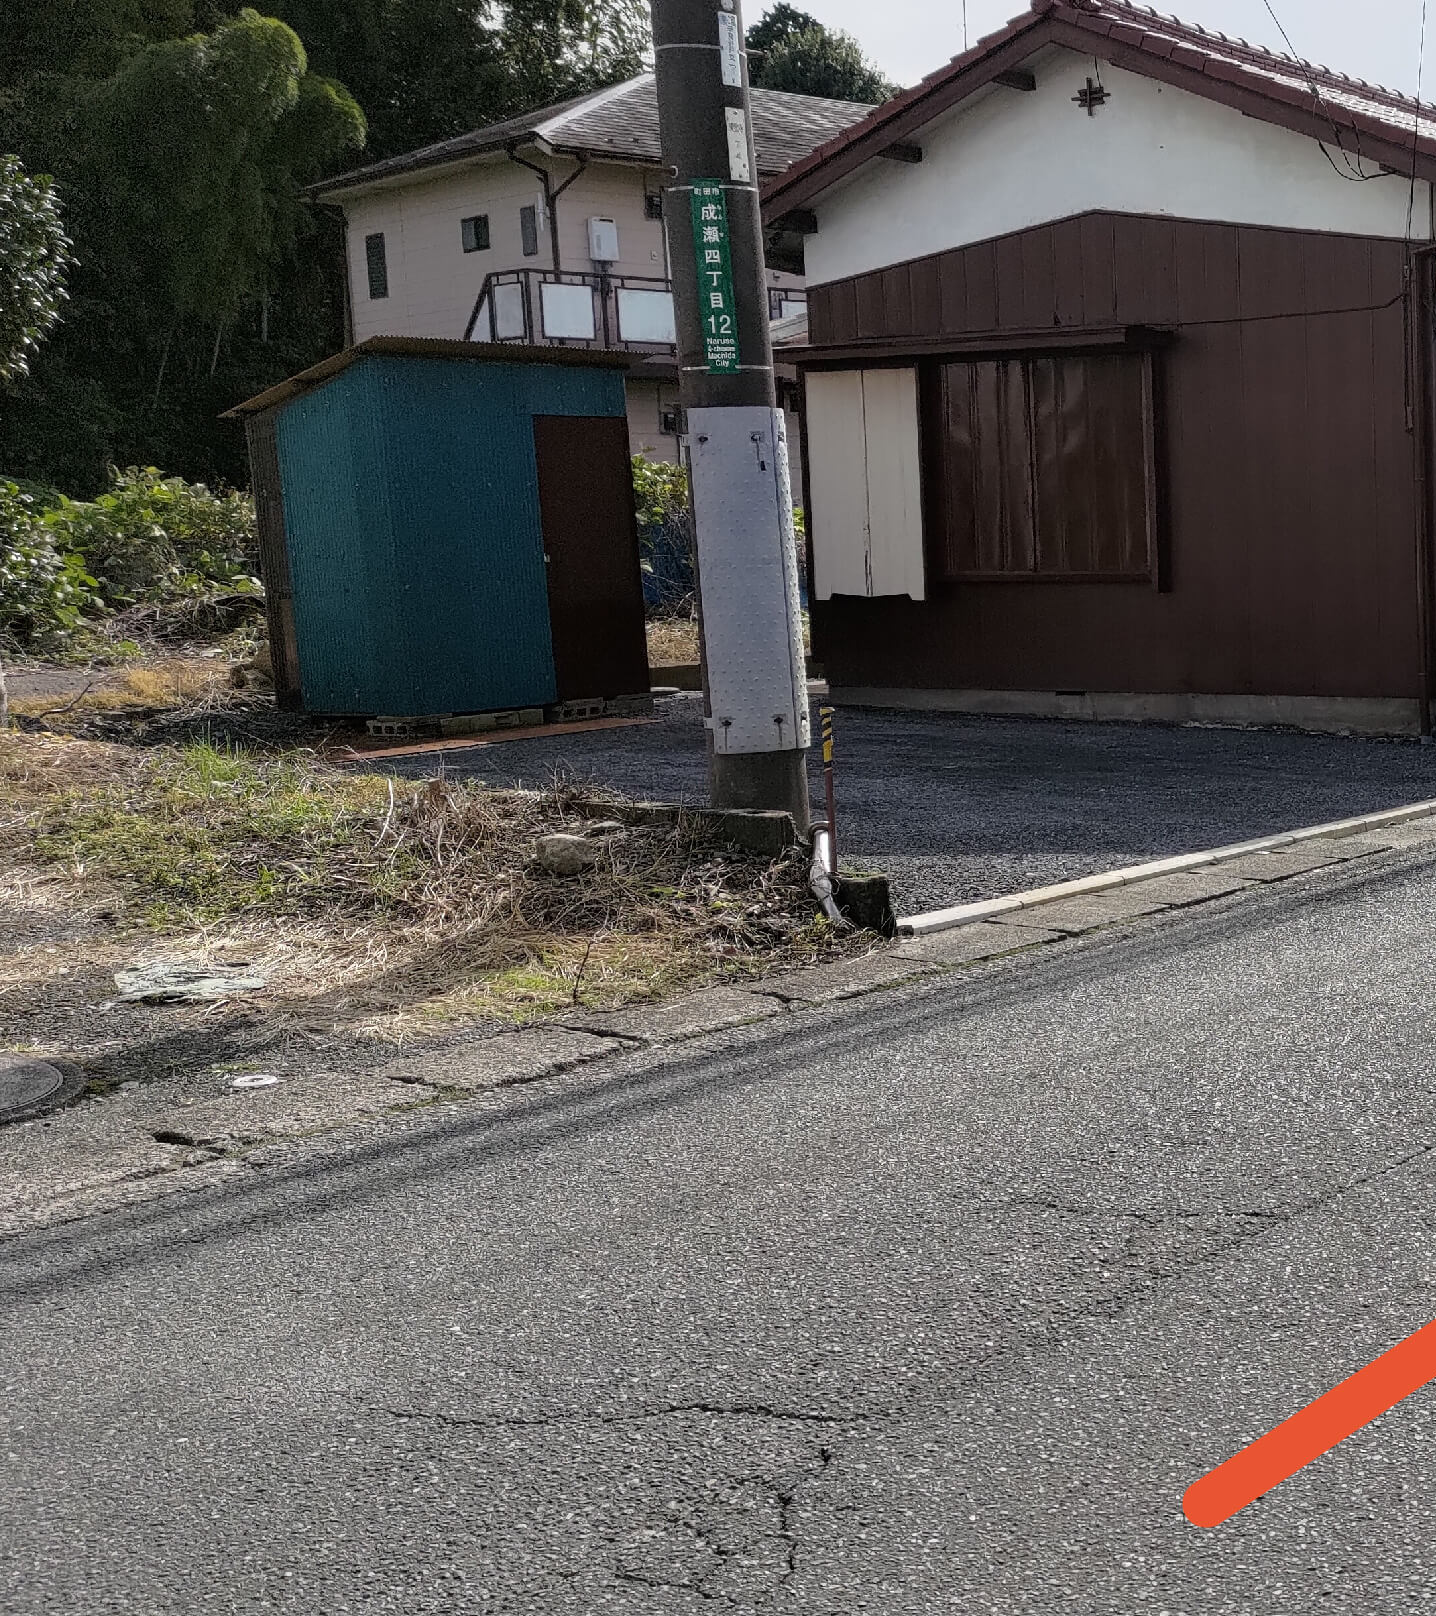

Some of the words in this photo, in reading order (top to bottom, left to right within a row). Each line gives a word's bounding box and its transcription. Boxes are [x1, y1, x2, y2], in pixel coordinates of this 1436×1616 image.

[694, 187, 720, 196] 町田市
[701, 203, 723, 308] 成瀬四丁目
[707, 314, 732, 334] 12
[706, 337, 735, 345] Naruse
[707, 352, 736, 360] Machida
